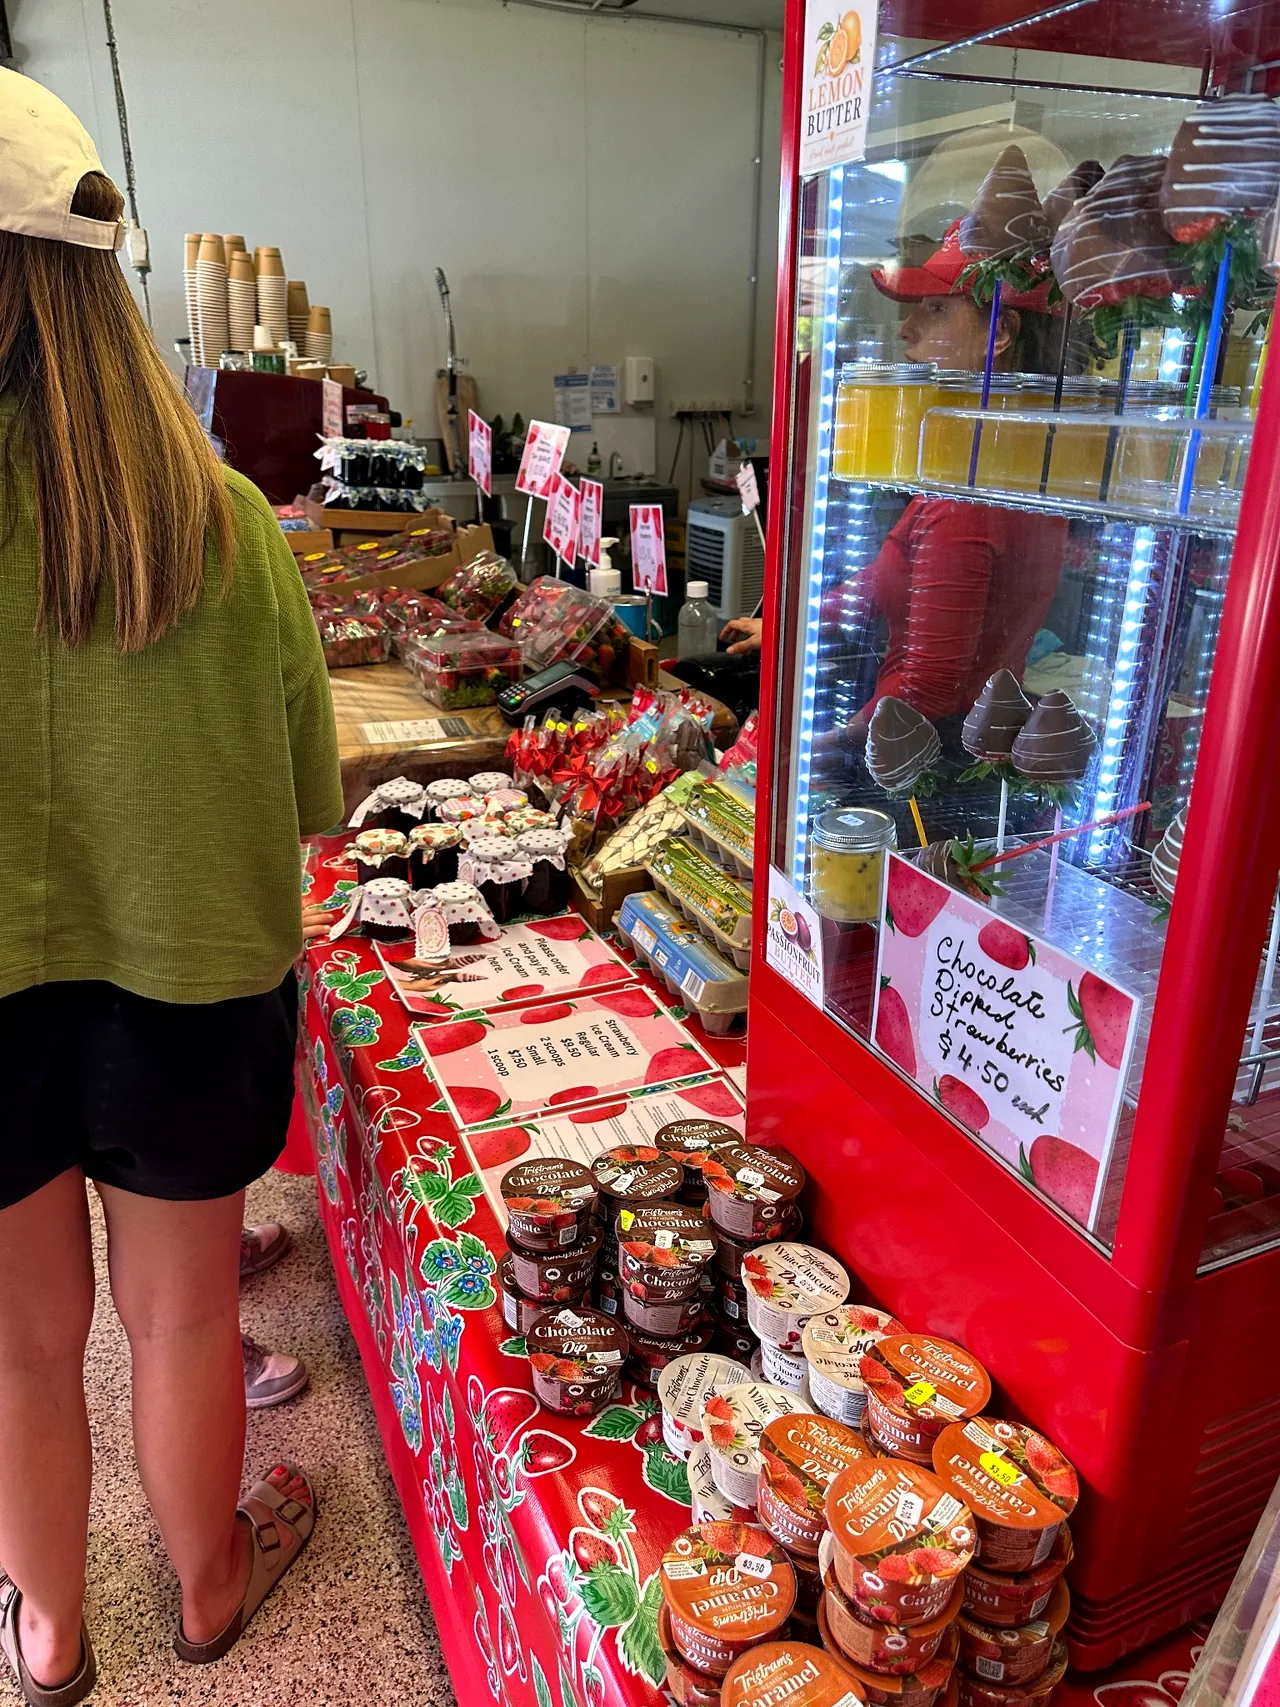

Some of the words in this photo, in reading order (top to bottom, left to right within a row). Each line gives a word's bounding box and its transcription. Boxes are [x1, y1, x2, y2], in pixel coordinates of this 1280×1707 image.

[808, 67, 865, 112] LEMON
[807, 96, 861, 137] BUTTER
[500, 946, 513, 958] Ice
[508, 955, 530, 979] Cream
[517, 941, 533, 955] and
[526, 952, 541, 969] pay
[535, 964, 550, 978] for
[534, 937, 559, 959] Please
[550, 955, 571, 976] order
[767, 922, 821, 984] PASSIONFRUIT
[774, 944, 812, 990] BUTTER
[936, 936, 1045, 1020] Chocolate
[937, 968, 1015, 1030] Dipped
[559, 1037, 582, 1059] $9.50
[575, 1031, 601, 1058] Regular
[589, 1023, 604, 1038] Ice
[597, 1035, 621, 1059] Cream
[605, 1018, 640, 1057] Strawberry
[931, 992, 1065, 1093] Strawberries
[489, 1054, 511, 1078] scoop
[507, 1049, 529, 1070] $7.50
[525, 1044, 547, 1066] Small
[544, 1042, 566, 1068] scoops
[661, 1127, 729, 1142] Chocolate
[508, 1168, 584, 1187] Chocolate
[519, 1162, 564, 1176] Tristram's
[731, 1148, 798, 1186] Chocolate
[536, 1184, 561, 1195] Dip
[632, 1218, 704, 1229] Chocolate
[637, 1208, 684, 1217] Tristram's
[774, 1244, 799, 1267] White
[797, 1263, 844, 1299] Chocolate
[664, 1289, 684, 1300] Dip
[535, 1326, 616, 1338] Chocolate
[561, 1340, 588, 1355] Dip
[899, 1343, 978, 1392] Caramel
[922, 1340, 975, 1376] Tristram's
[665, 1364, 690, 1400] Tristram's
[676, 1397, 693, 1419] White
[688, 1355, 711, 1400] Chocolate
[772, 1371, 789, 1387] Dip
[747, 1386, 771, 1415] White
[787, 1429, 850, 1470] Caram
[807, 1421, 863, 1460] Tristram's
[878, 1429, 899, 1451] Dip
[948, 1453, 1038, 1517] Caramel
[989, 1464, 1011, 1483] $3.50
[836, 1468, 888, 1514] Tristram's
[845, 1472, 915, 1537] Caramel
[859, 1487, 886, 1513] PREMIUM
[951, 1474, 1011, 1520] Tristram's
[770, 1522, 794, 1545] Dip
[709, 1567, 743, 1587] Dip
[742, 1559, 765, 1574] $3.50
[690, 1581, 779, 1617] Caramel
[712, 1602, 778, 1629] Tristram's
[685, 1648, 711, 1669] Dip
[733, 1651, 794, 1694] Tristram's
[755, 1670, 789, 1694] PREMIUM
